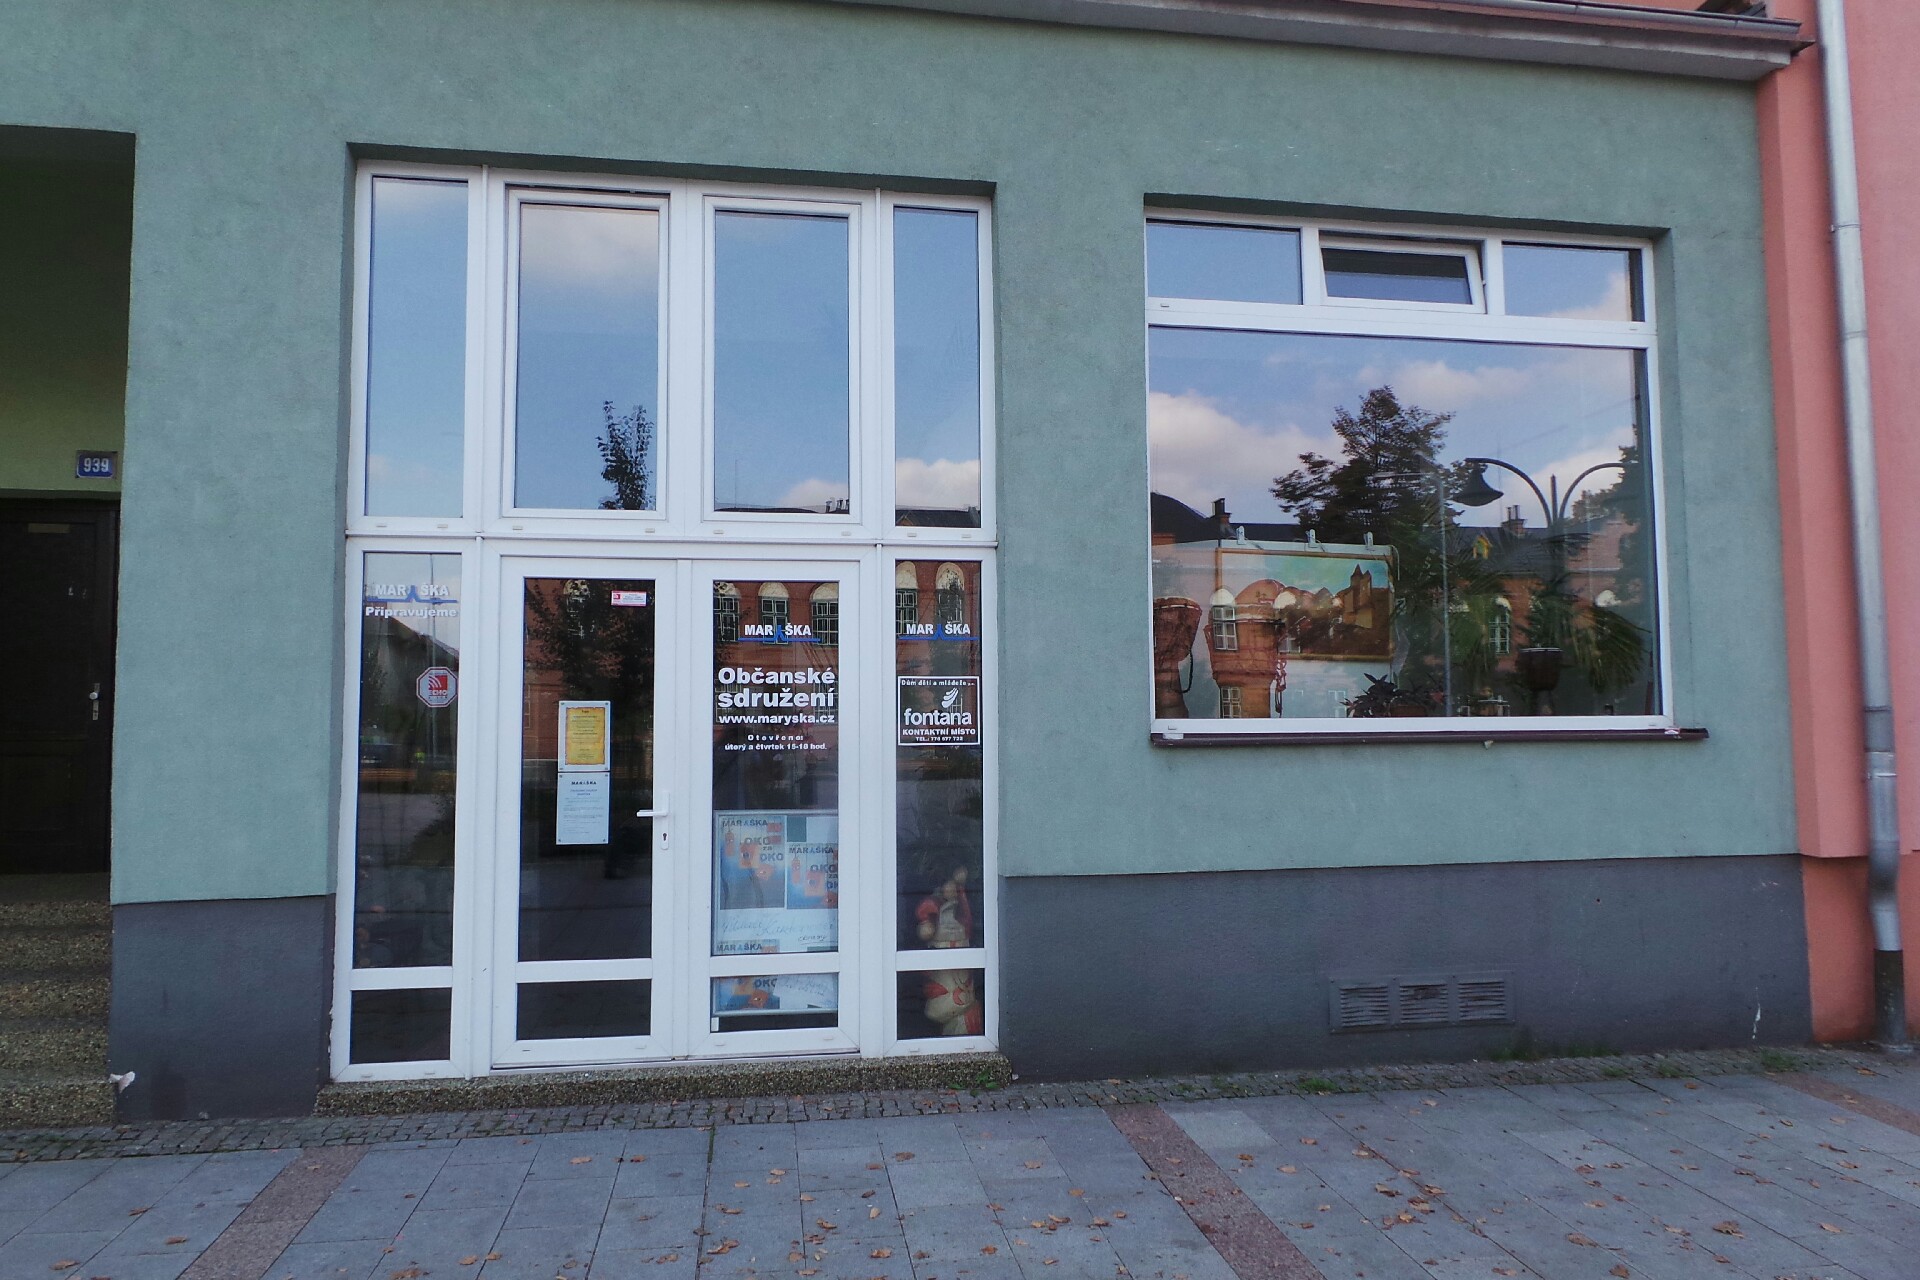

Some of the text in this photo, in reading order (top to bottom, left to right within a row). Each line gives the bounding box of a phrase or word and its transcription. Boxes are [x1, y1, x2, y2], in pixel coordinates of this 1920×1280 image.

[84, 458, 109, 472] 939
[365, 606, 457, 618] Připravujeme
[718, 667, 835, 684] Občanské
[717, 688, 834, 707] sdružení
[719, 713, 834, 725] www.maryska.cz
[904, 708, 972, 726] fontana
[951, 727, 976, 735] MÍSTO
[725, 743, 746, 751] úterý
[760, 852, 784, 862] OKO
